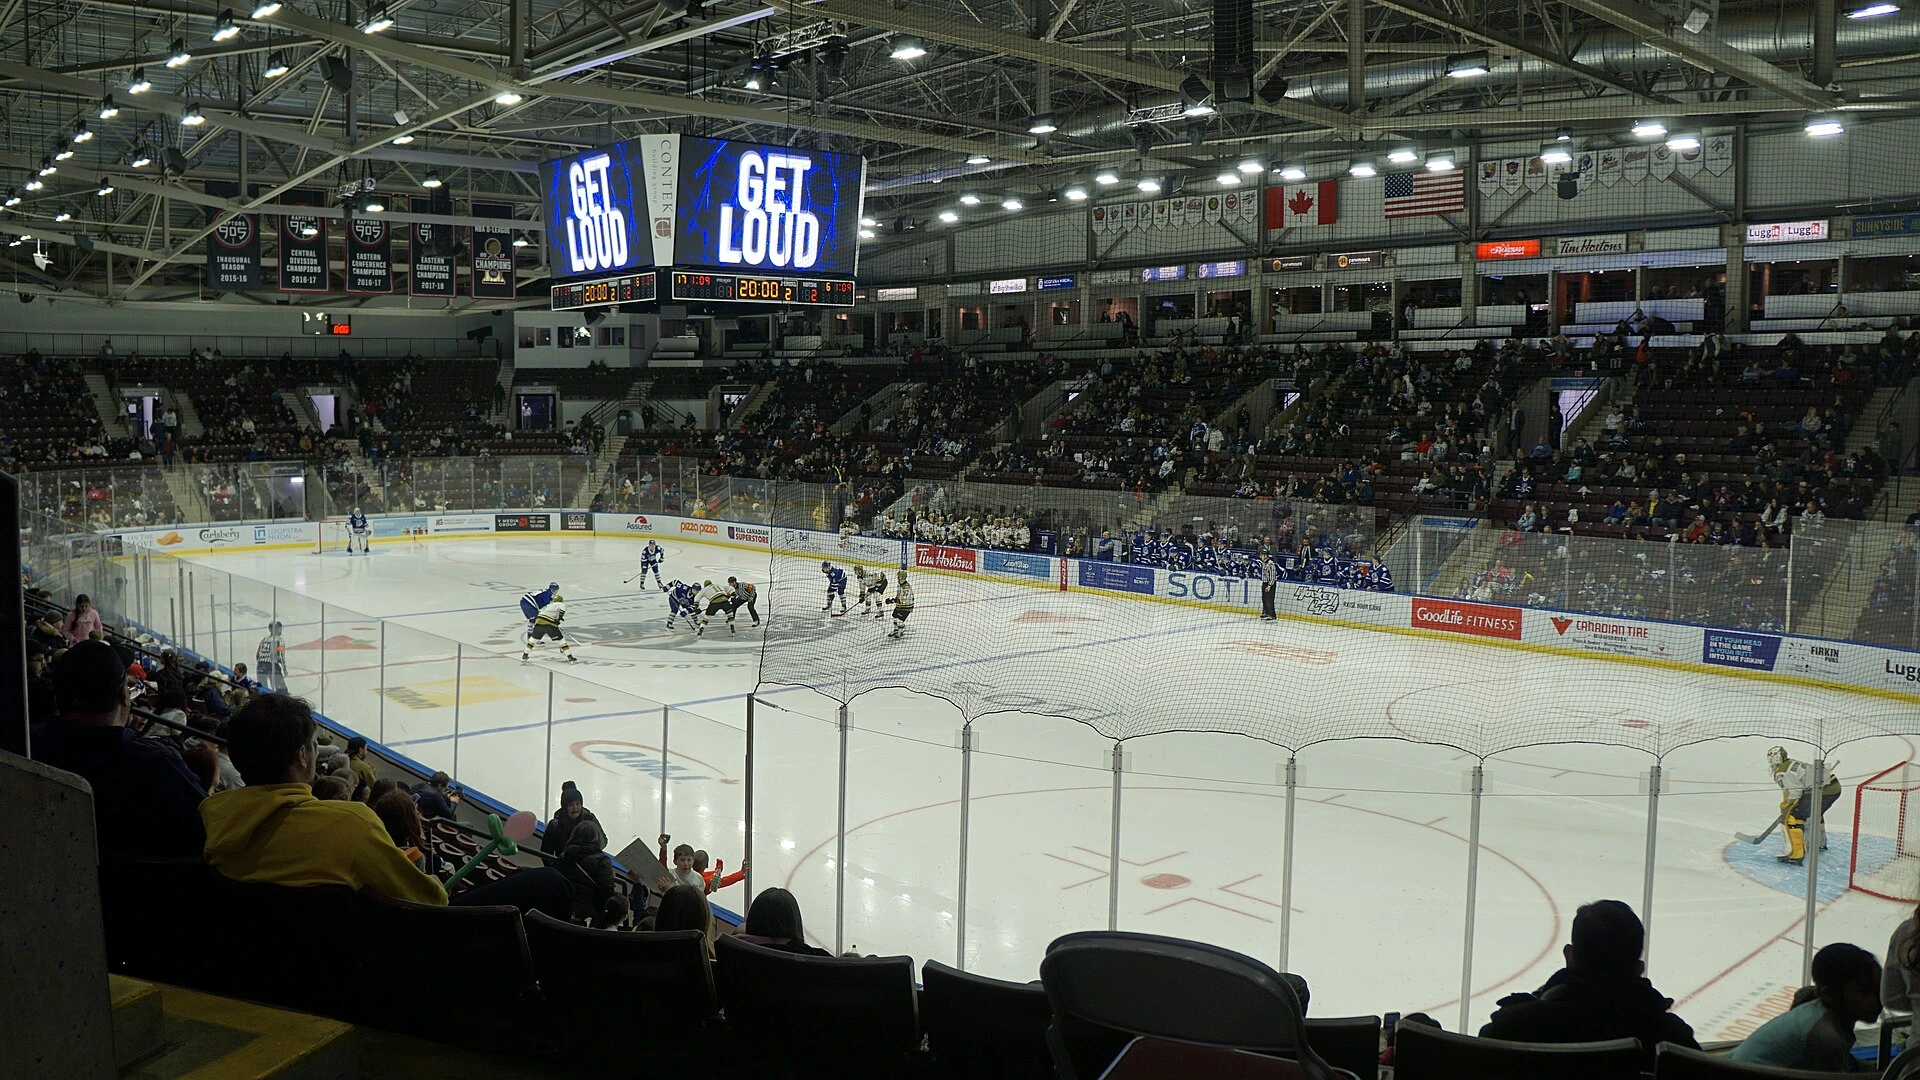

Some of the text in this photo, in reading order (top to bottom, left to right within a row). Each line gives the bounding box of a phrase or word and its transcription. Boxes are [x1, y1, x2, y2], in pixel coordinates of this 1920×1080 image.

[660, 139, 673, 213] CONTEK
[738, 151, 811, 213] GET
[569, 153, 612, 220] GET
[1855, 218, 1905, 233] SUNNYSIDE
[355, 225, 381, 239] 905
[719, 203, 819, 268] LOUD
[566, 208, 628, 272] LOUD
[1560, 238, 1622, 254] Tim Hortons
[291, 249, 316, 257] CENTRAL
[216, 256, 251, 264] INAUGURAL
[290, 257, 318, 265] DIVISION
[352, 260, 387, 268] CONFERENCE
[421, 256, 445, 264] EASTERN
[475, 260, 511, 270] CHAMPIONS
[221, 263, 245, 271] SEASON
[286, 265, 322, 273] CHAMPIONS
[353, 268, 387, 276] CHAMPIONS
[416, 264, 450, 272] CONFERENCE
[220, 274, 248, 283] 2015-16
[291, 275, 317, 284] 2016-17
[357, 278, 382, 286] 2016-17
[417, 272, 450, 280] CHAMPIONS
[677, 275, 687, 285] 17
[691, 275, 711, 286] 1:09
[585, 283, 609, 302] 20:00
[739, 280, 779, 299] 20:00
[825, 281, 832, 292] 6
[610, 287, 616, 301] 2
[784, 287, 793, 301] 2
[810, 288, 818, 302] 2
[626, 522, 652, 531] Assured
[681, 521, 718, 535] pizza pizza
[747, 527, 769, 536] CANADIAN
[199, 529, 241, 541] Carlsberg
[735, 533, 770, 544] SUPERSTORE
[917, 548, 934, 565] Tim
[935, 549, 974, 570] Hortons
[1167, 571, 1249, 605] SOTI
[1293, 585, 1339, 603] Hockey
[1416, 607, 1516, 631] GoodLife FITNESS
[1576, 620, 1649, 639] CANADIAN TIRE
[1709, 635, 1763, 647] GET YOUR HEAD
[1709, 641, 1752, 652] IN THE GAME
[1715, 647, 1734, 656] YOUR
[1810, 645, 1840, 658] FIRKIN
[1709, 652, 1765, 666] INTO THE FIRKIN!
